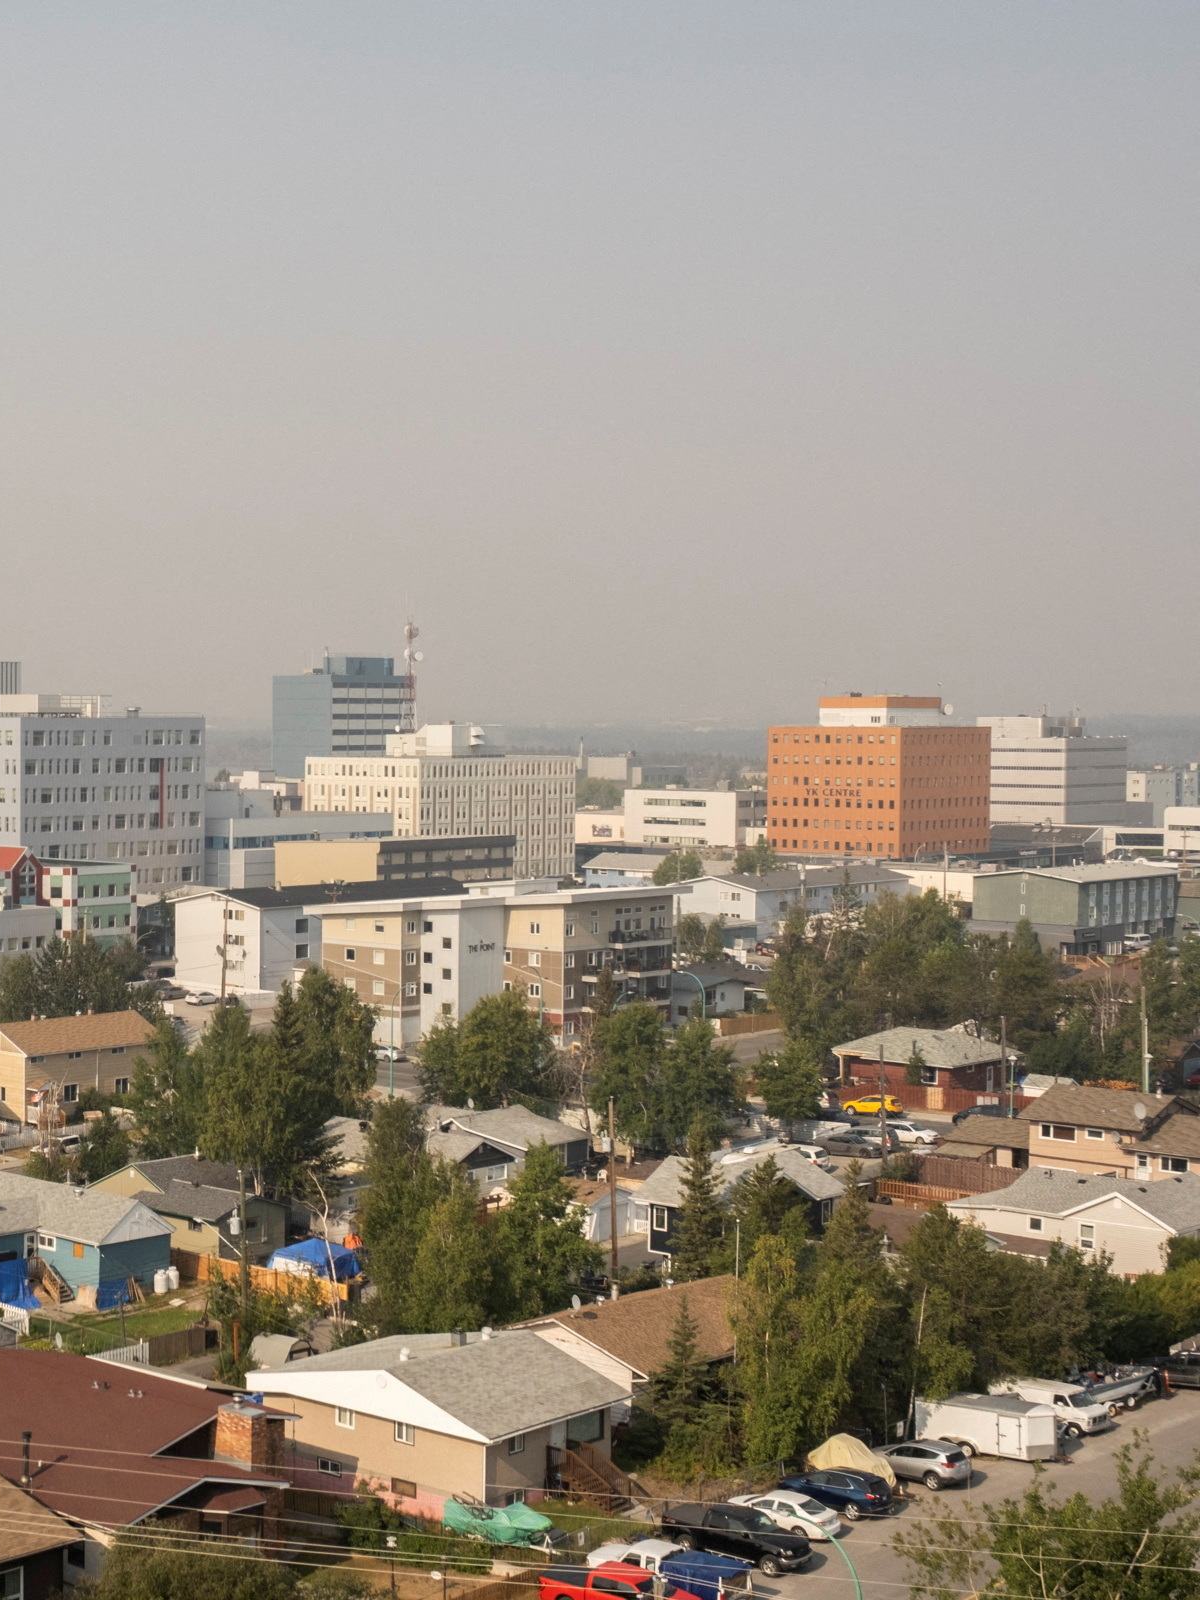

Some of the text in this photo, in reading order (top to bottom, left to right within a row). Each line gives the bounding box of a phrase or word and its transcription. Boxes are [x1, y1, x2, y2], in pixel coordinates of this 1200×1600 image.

[805, 788, 861, 797] YK CENTRE
[468, 942, 495, 954] THE POINT
